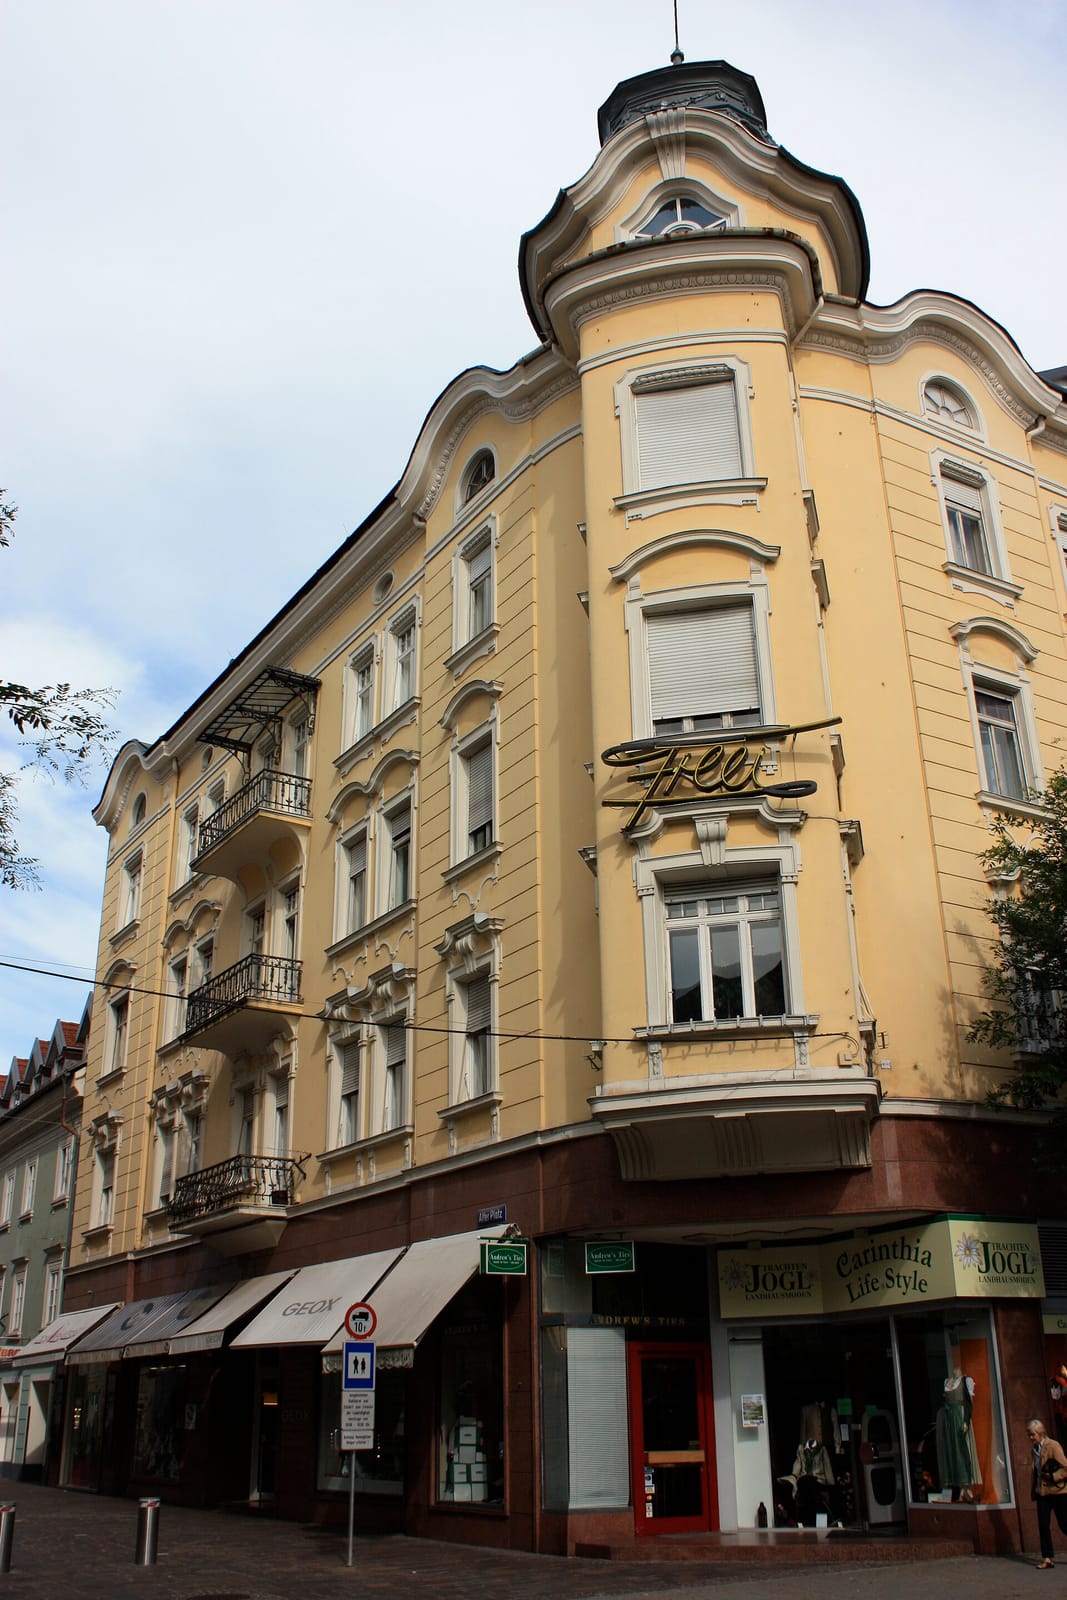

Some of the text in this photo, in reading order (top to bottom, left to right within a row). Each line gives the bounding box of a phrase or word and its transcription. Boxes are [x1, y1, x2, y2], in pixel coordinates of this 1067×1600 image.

[490, 1208, 503, 1221] Platz
[992, 1242, 1030, 1251] TRACHTEN
[491, 1253, 512, 1261] Andrew's
[591, 1251, 616, 1259] Andrew's
[836, 1236, 932, 1279] Carinthia
[977, 1241, 1035, 1275] JOGL
[763, 1263, 808, 1272] TRACHTEN
[745, 1264, 812, 1293] JOGL
[978, 1275, 1036, 1284] LANDHAUSMODEN
[845, 1267, 928, 1303] Life Style
[745, 1290, 812, 1301] LANDHAUSMODEN
[282, 1296, 343, 1317] GEOX
